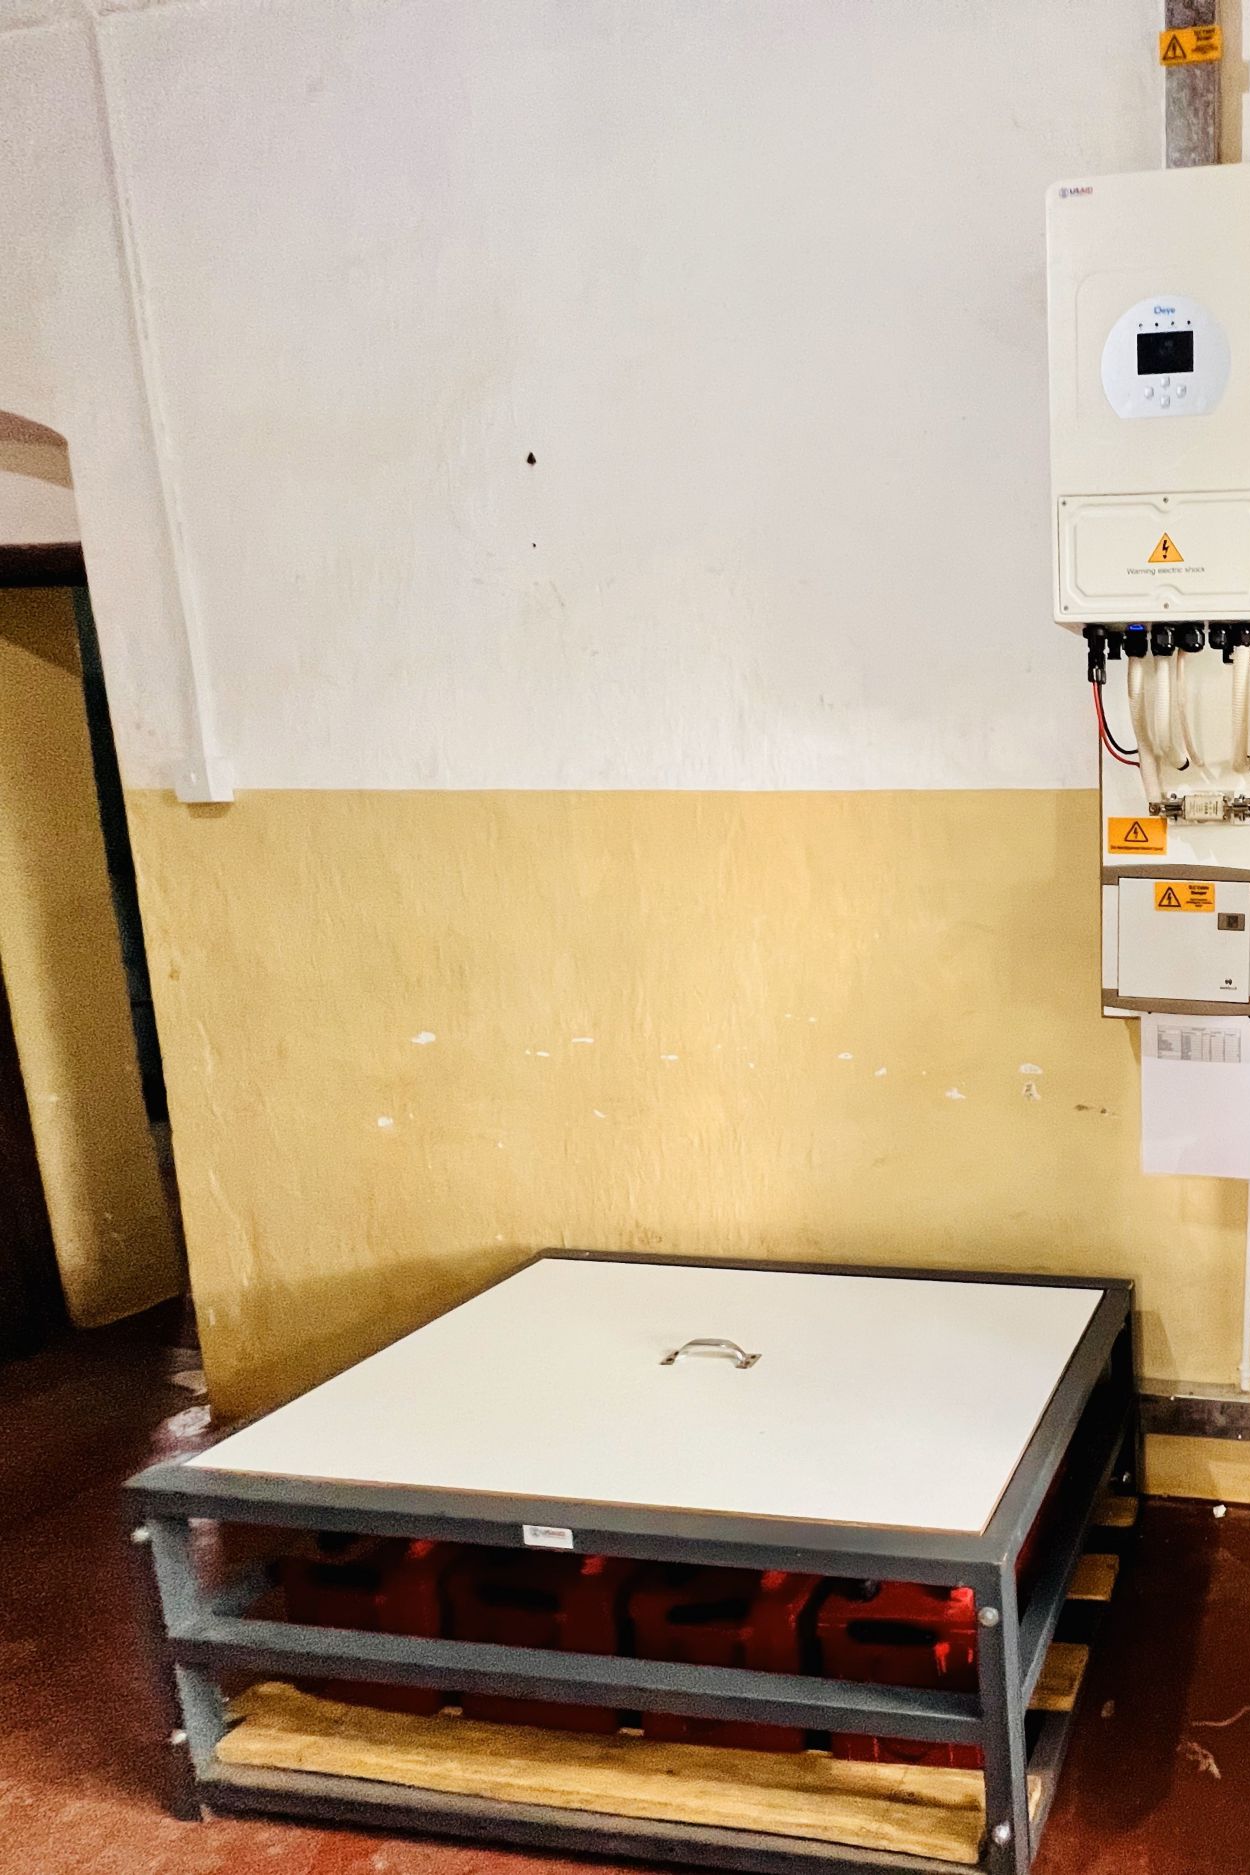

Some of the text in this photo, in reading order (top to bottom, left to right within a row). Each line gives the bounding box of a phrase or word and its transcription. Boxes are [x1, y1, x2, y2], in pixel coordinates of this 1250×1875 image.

[1126, 565, 1206, 576] Warning electric shock
